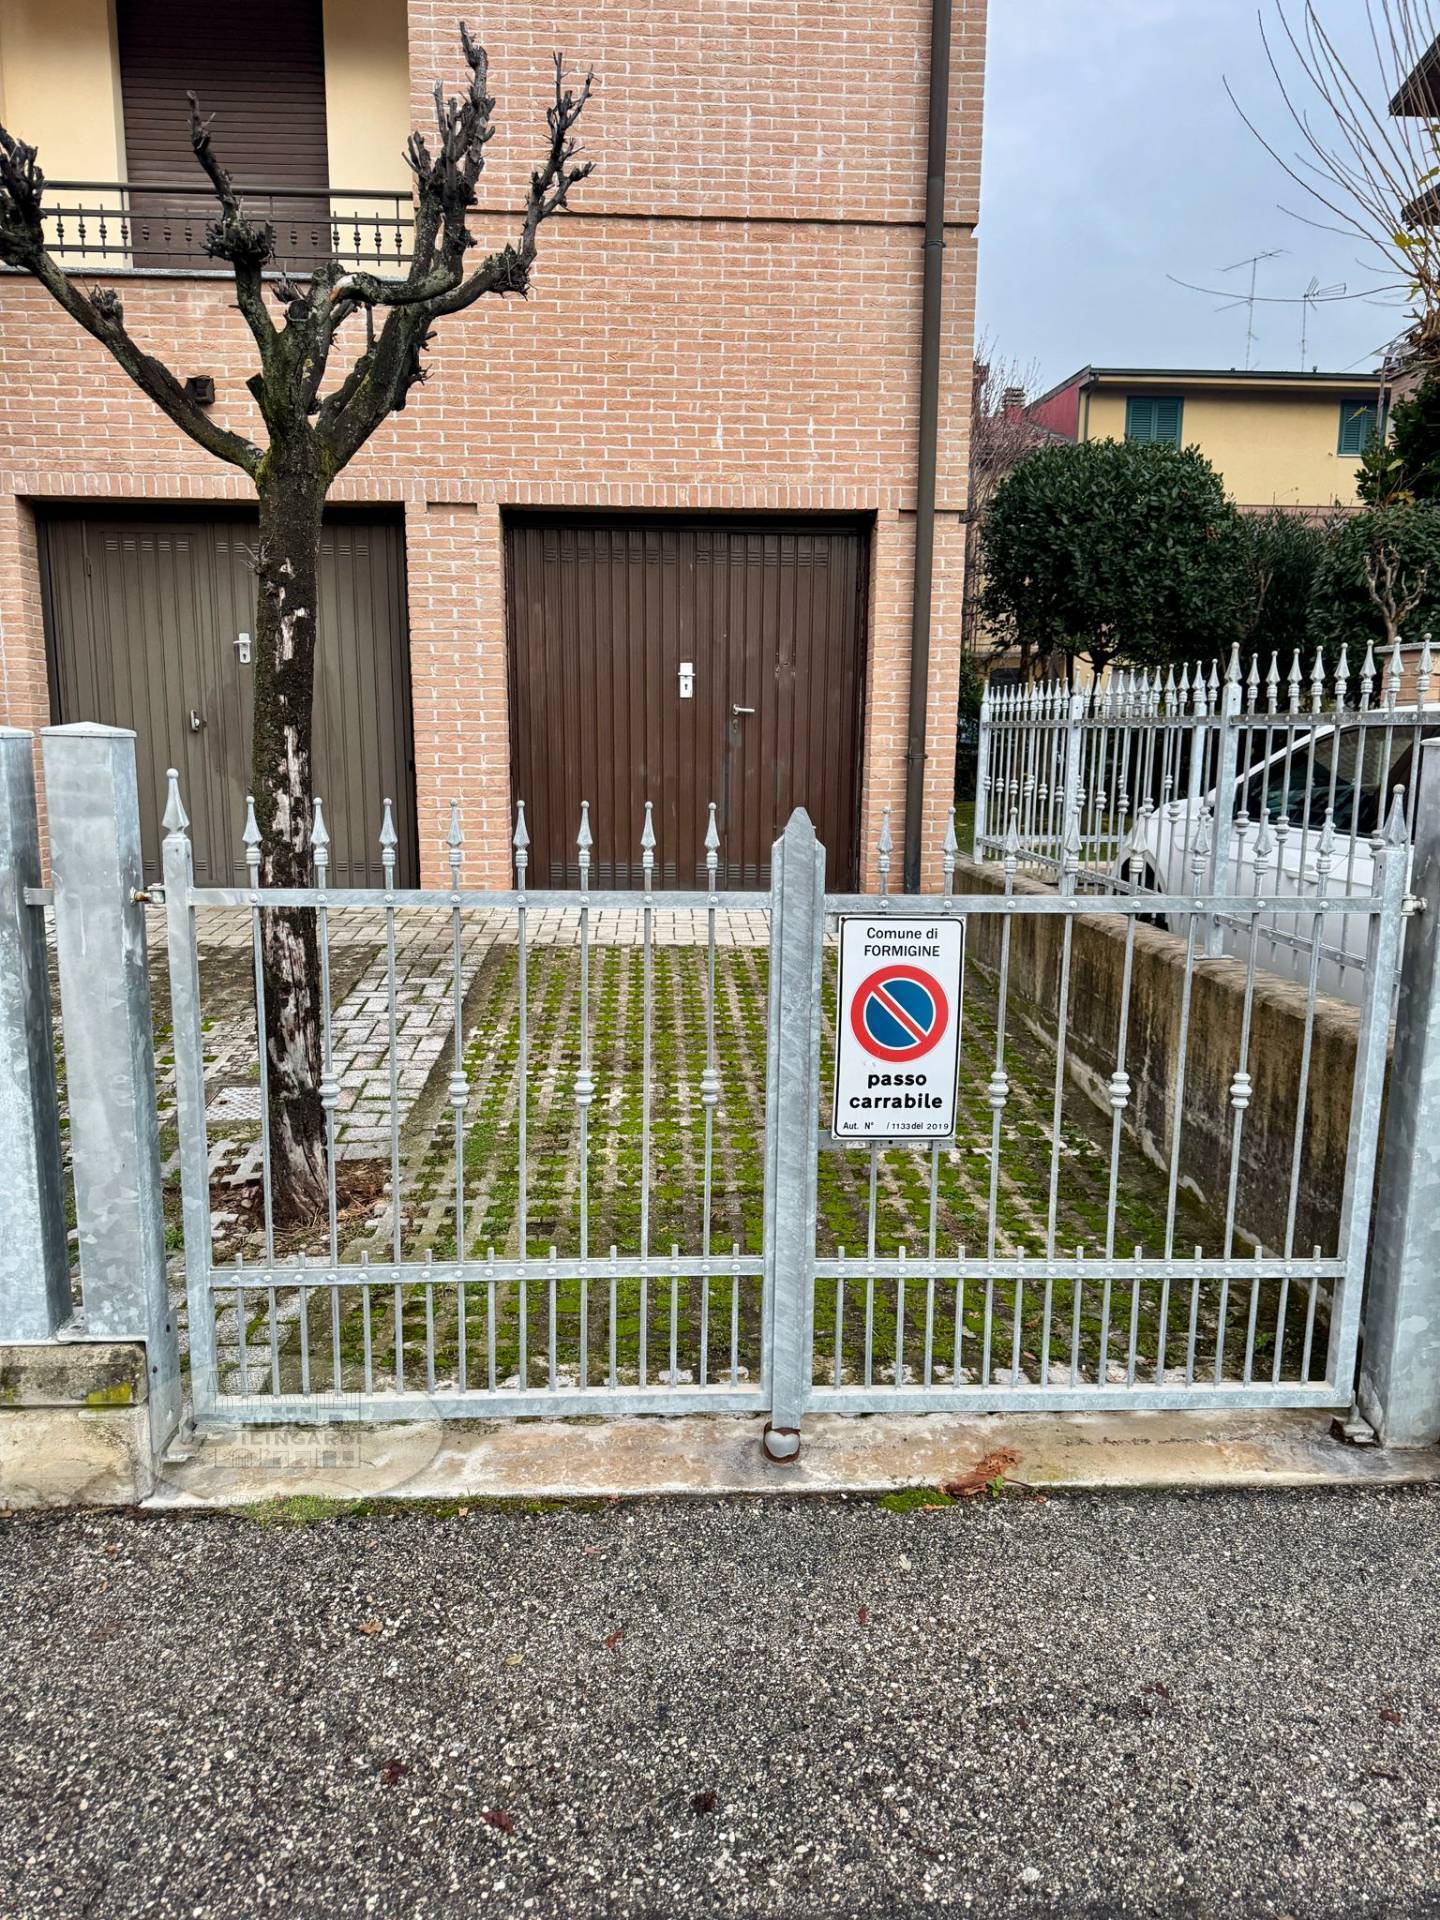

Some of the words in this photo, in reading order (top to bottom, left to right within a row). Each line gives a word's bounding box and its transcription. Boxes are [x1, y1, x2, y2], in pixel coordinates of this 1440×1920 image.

[866, 927, 922, 939] Comune
[926, 928, 938, 939] di
[864, 945, 941, 957] FORMIGINE
[868, 1074, 927, 1089] passo
[849, 1093, 943, 1109] carrabile
[842, 1122, 859, 1130] Aut.
